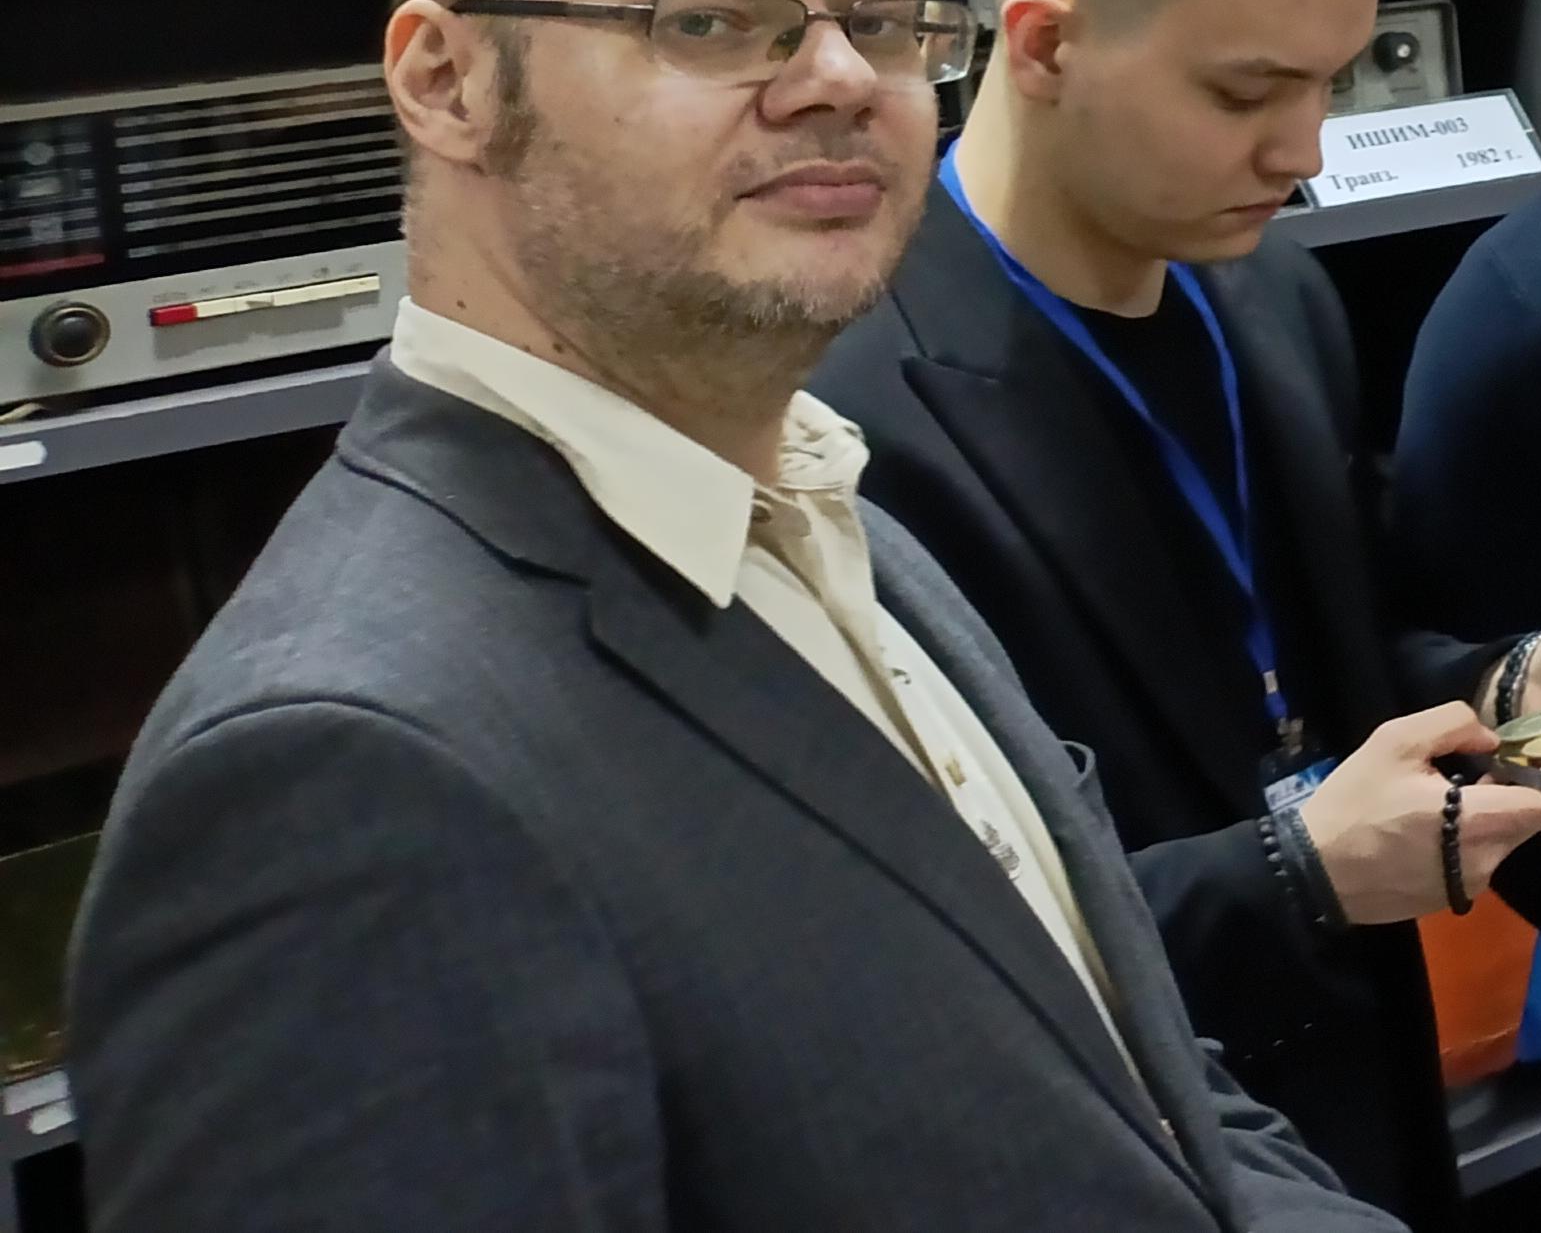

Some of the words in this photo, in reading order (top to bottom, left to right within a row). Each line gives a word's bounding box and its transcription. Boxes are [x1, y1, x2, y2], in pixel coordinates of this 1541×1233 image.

[1345, 116, 1469, 150] ИШИМ-003
[1326, 169, 1399, 192] Транз.
[1456, 147, 1501, 169] 1982
